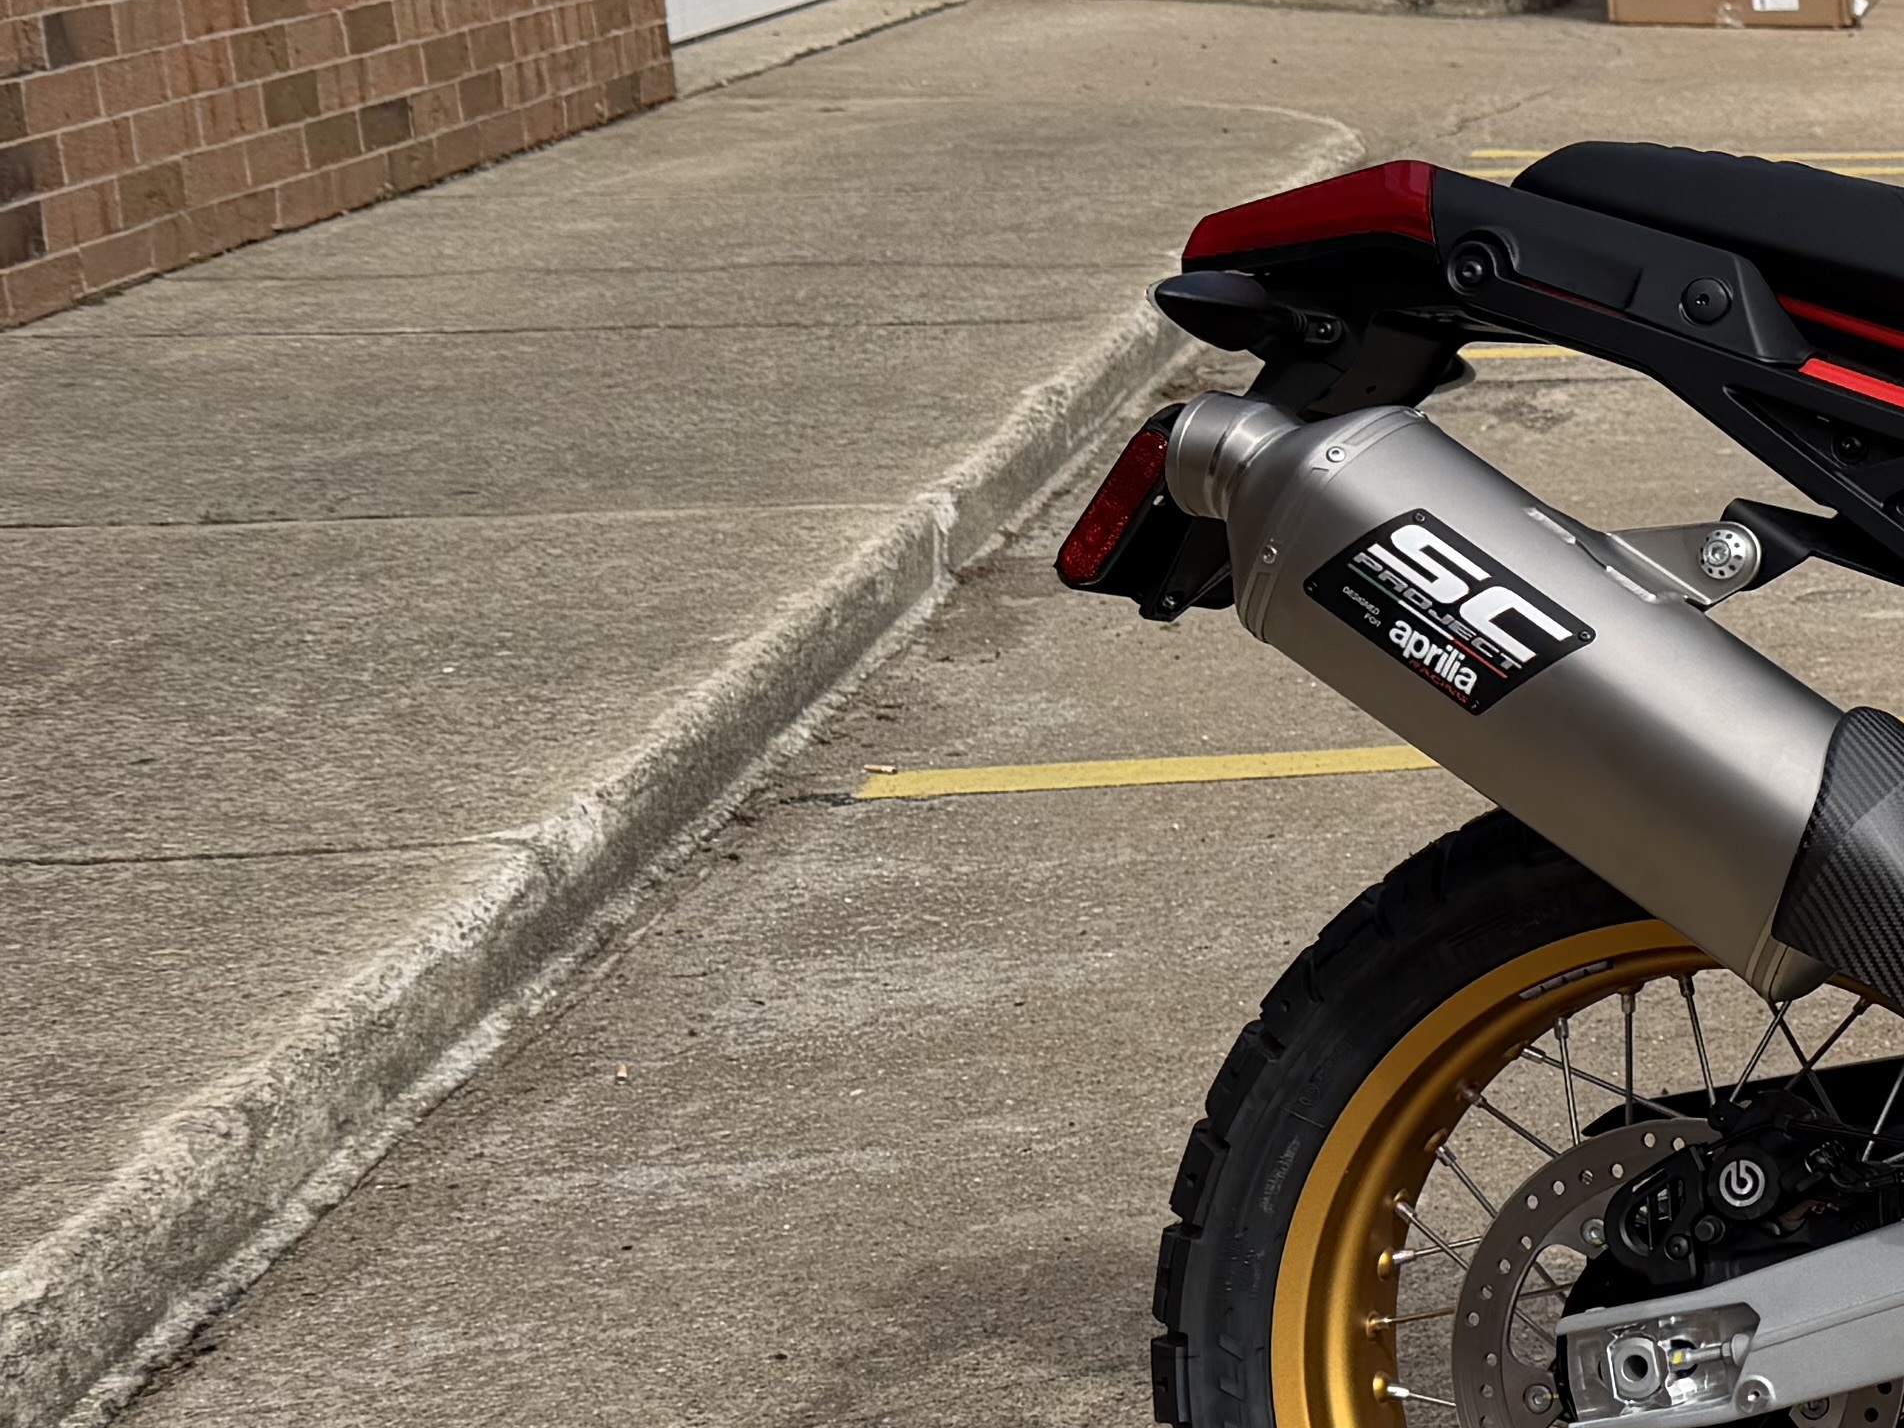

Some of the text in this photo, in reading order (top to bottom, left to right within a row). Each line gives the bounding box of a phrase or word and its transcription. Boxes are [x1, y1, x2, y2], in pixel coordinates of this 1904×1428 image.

[1341, 585, 1381, 617] DESIGNED
[1352, 551, 1524, 671] PROJECT
[1363, 612, 1383, 628] FOR
[1366, 524, 1575, 664] SC
[1388, 619, 1479, 695] aprilia
[1407, 659, 1470, 704] RACING
